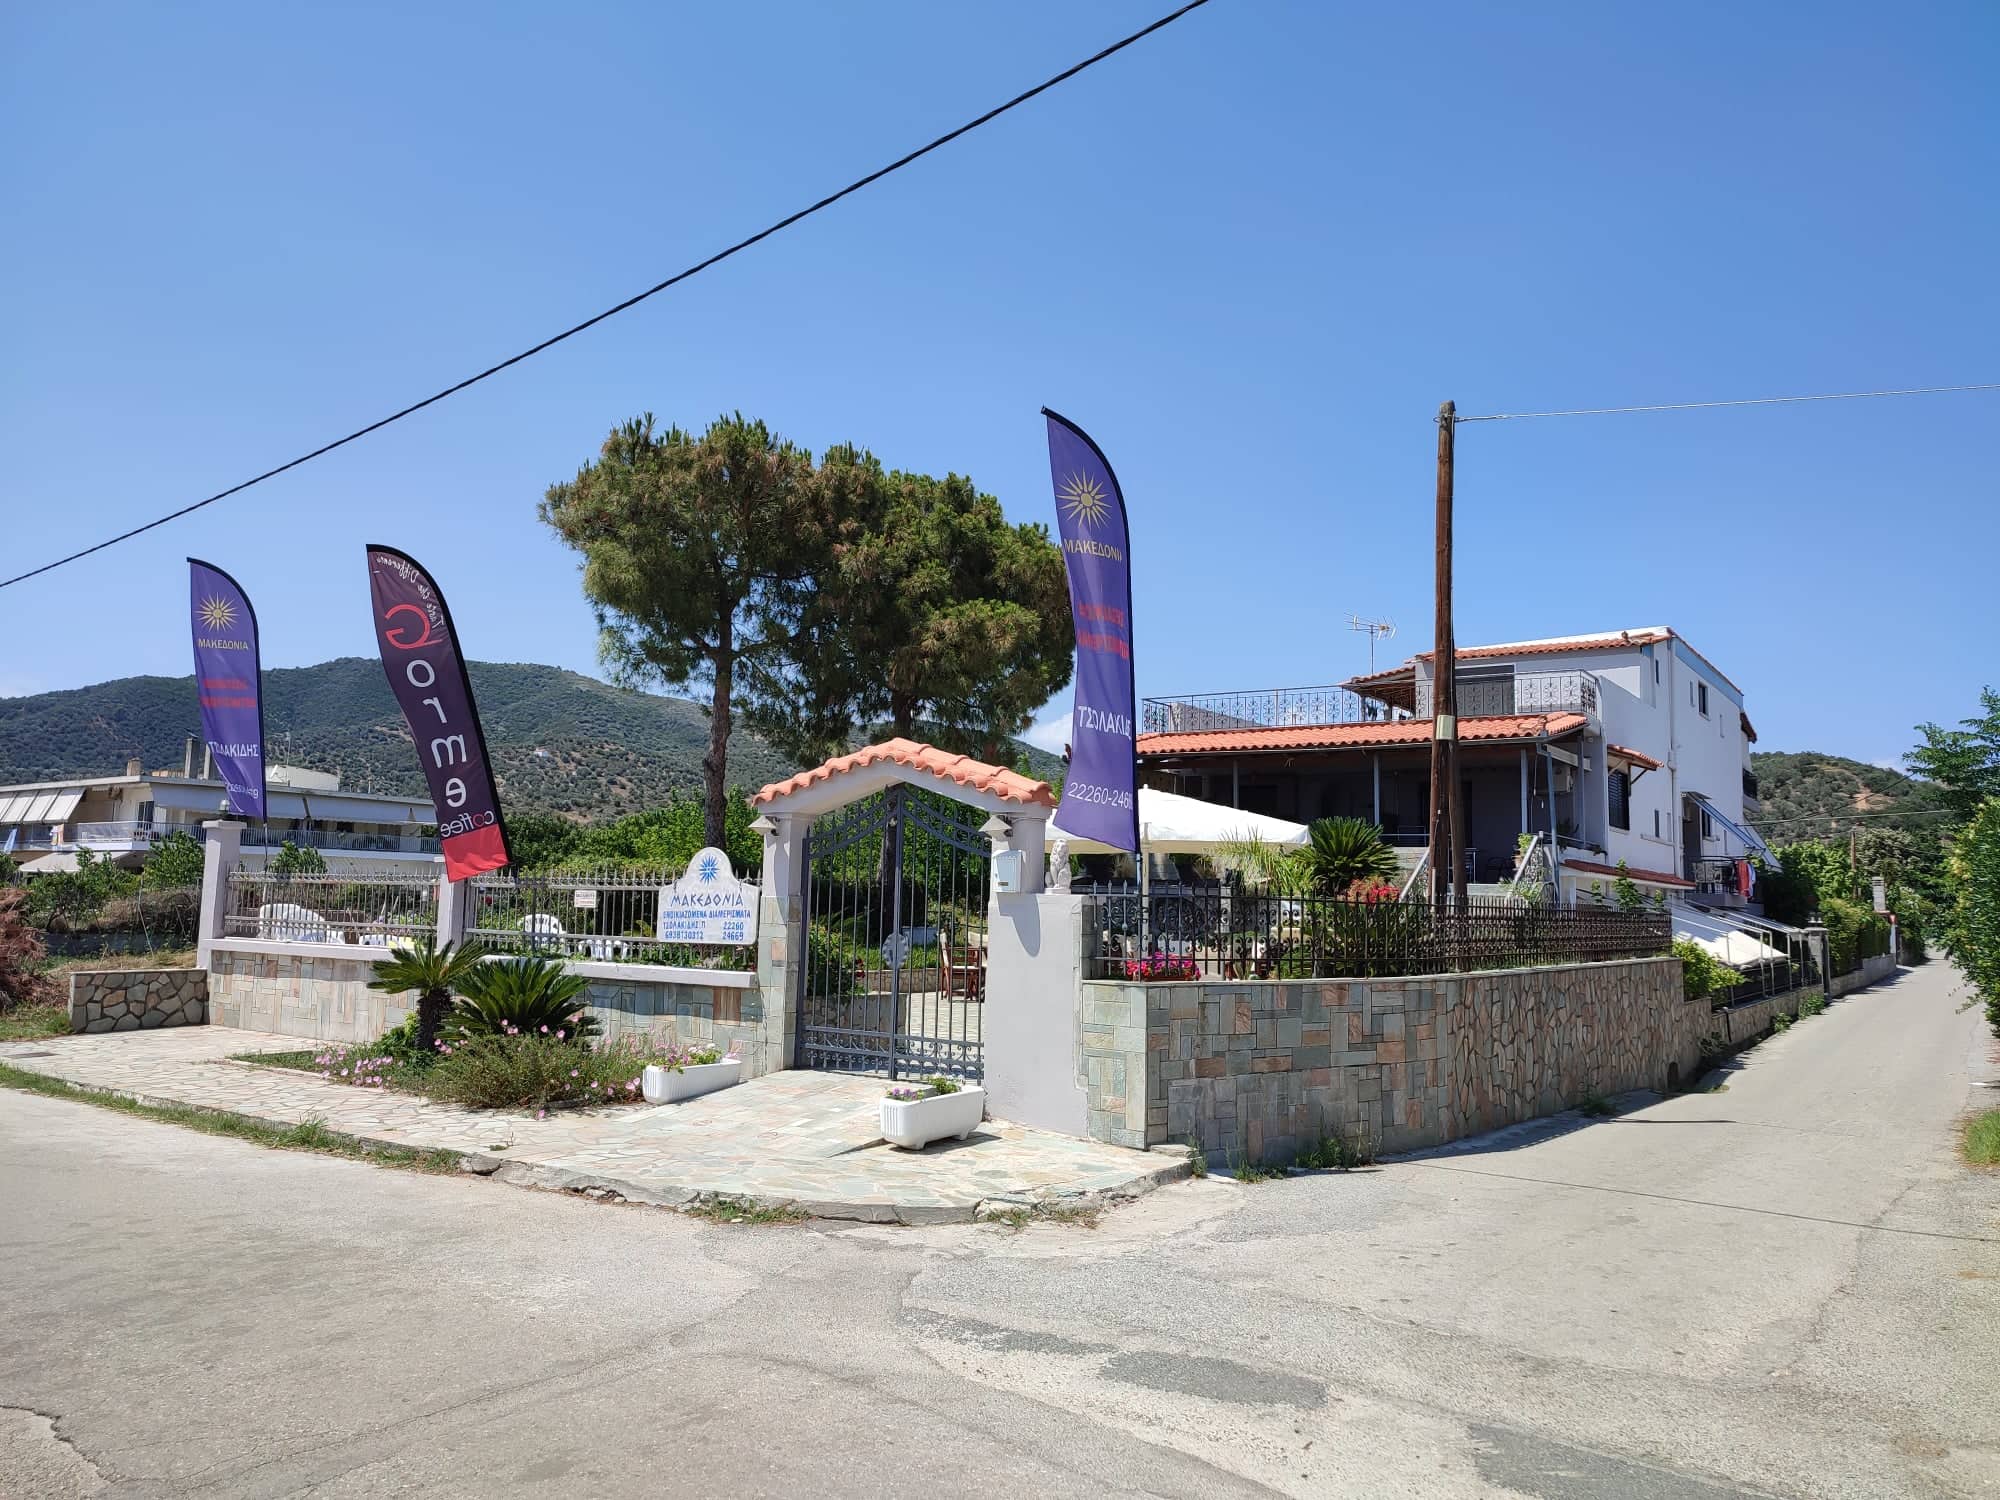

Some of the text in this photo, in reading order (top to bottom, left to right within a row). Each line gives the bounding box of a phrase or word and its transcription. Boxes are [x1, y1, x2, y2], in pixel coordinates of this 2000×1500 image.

[198, 638, 249, 650] ΜΑΚΕΔΟΝΙΑ
[1077, 705, 1132, 741] ΤΣΟΛΑΚΙ
[1067, 782, 1133, 810] 22260-246
[671, 893, 743, 906] ΜΑΚΕΔΟΝΙΑ
[723, 922, 744, 931] 22260
